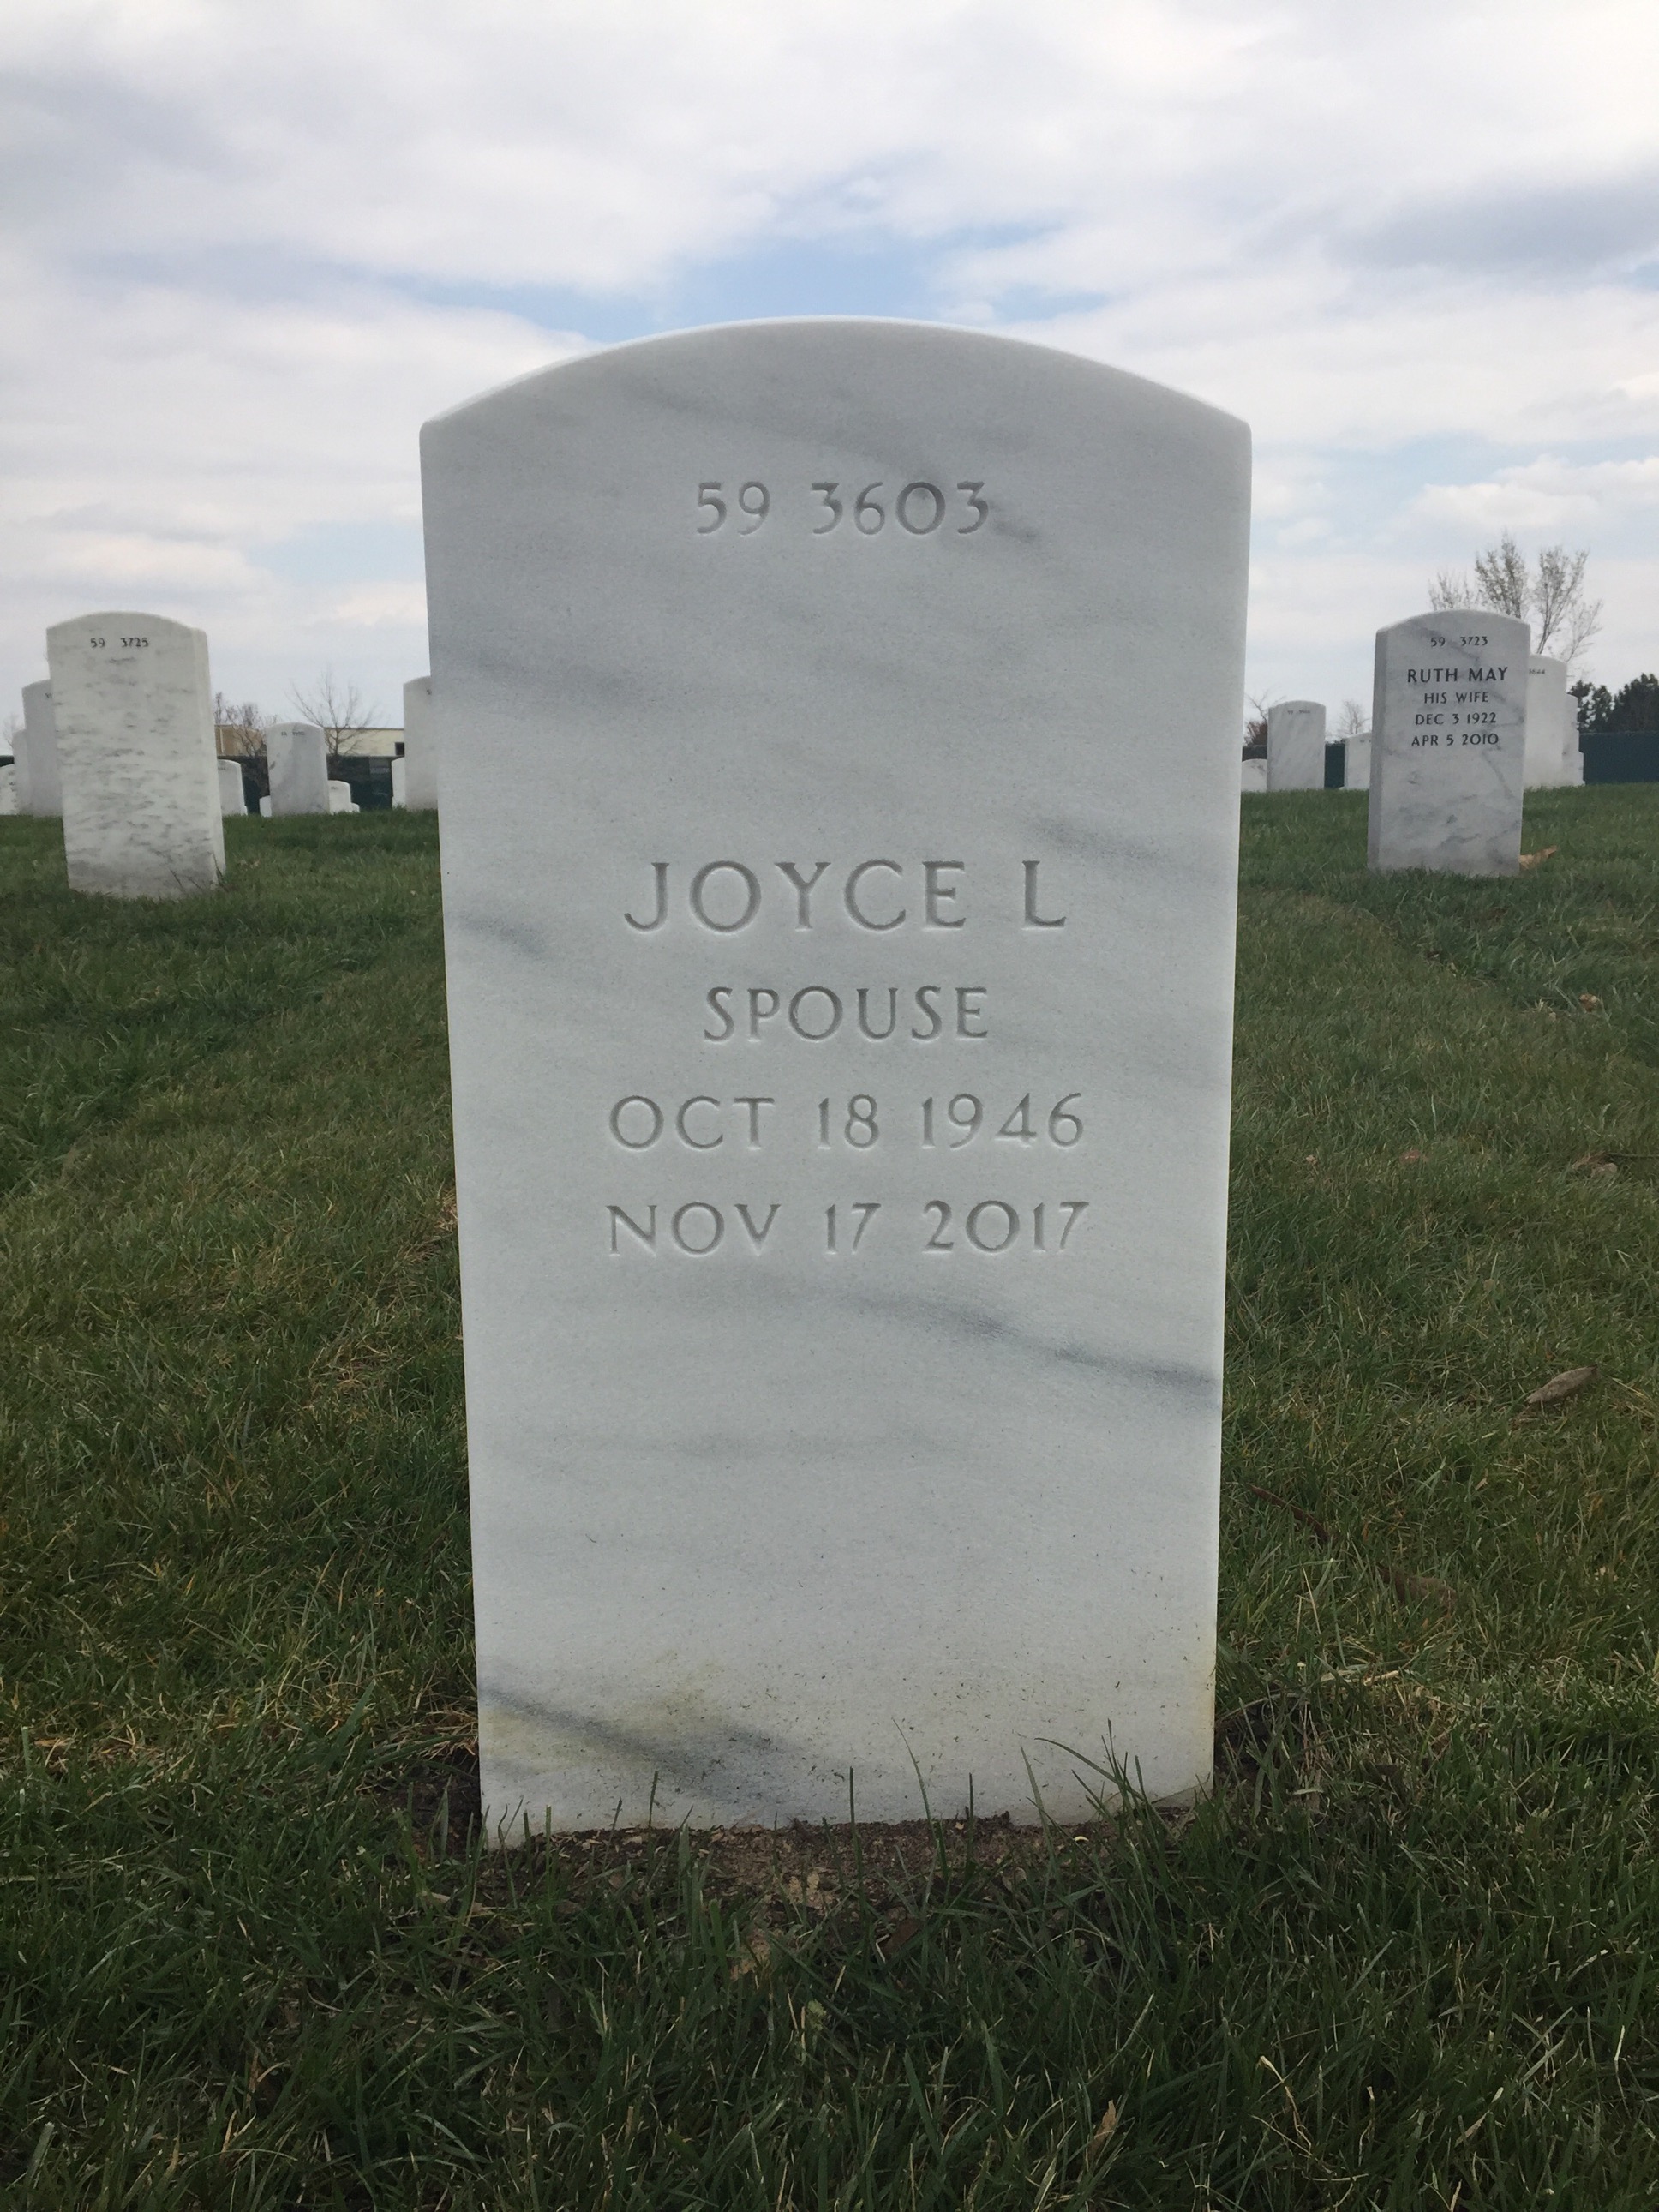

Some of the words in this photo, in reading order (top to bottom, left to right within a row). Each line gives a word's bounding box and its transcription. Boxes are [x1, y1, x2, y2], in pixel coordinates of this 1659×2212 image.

[696, 481, 770, 536] 59
[811, 481, 990, 536] 3603
[90, 638, 105, 648] 59
[120, 637, 149, 648] 3725
[1430, 637, 1446, 647] 59
[1459, 636, 1488, 646] 3723
[1407, 668, 1458, 683] RUTH
[1468, 667, 1508, 682] MAY
[1423, 692, 1447, 704] HIS
[1456, 691, 1489, 703] WIFE
[1415, 713, 1445, 725] DEC
[1452, 713, 1460, 725] 3
[1466, 712, 1497, 724] 1922
[1411, 734, 1439, 746] APR
[1446, 734, 1454, 746] 5
[1462, 733, 1500, 746] 2010
[623, 859, 967, 933] JOYCE
[1021, 860, 1067, 930] L
[703, 986, 989, 1042] SPOUSE
[608, 1094, 776, 1150] OCT
[817, 1094, 882, 1150] 18
[920, 1092, 1085, 1150] 1946
[605, 1201, 782, 1256] NOV
[824, 1202, 883, 1255] 17
[921, 1199, 1091, 1255] 2017
